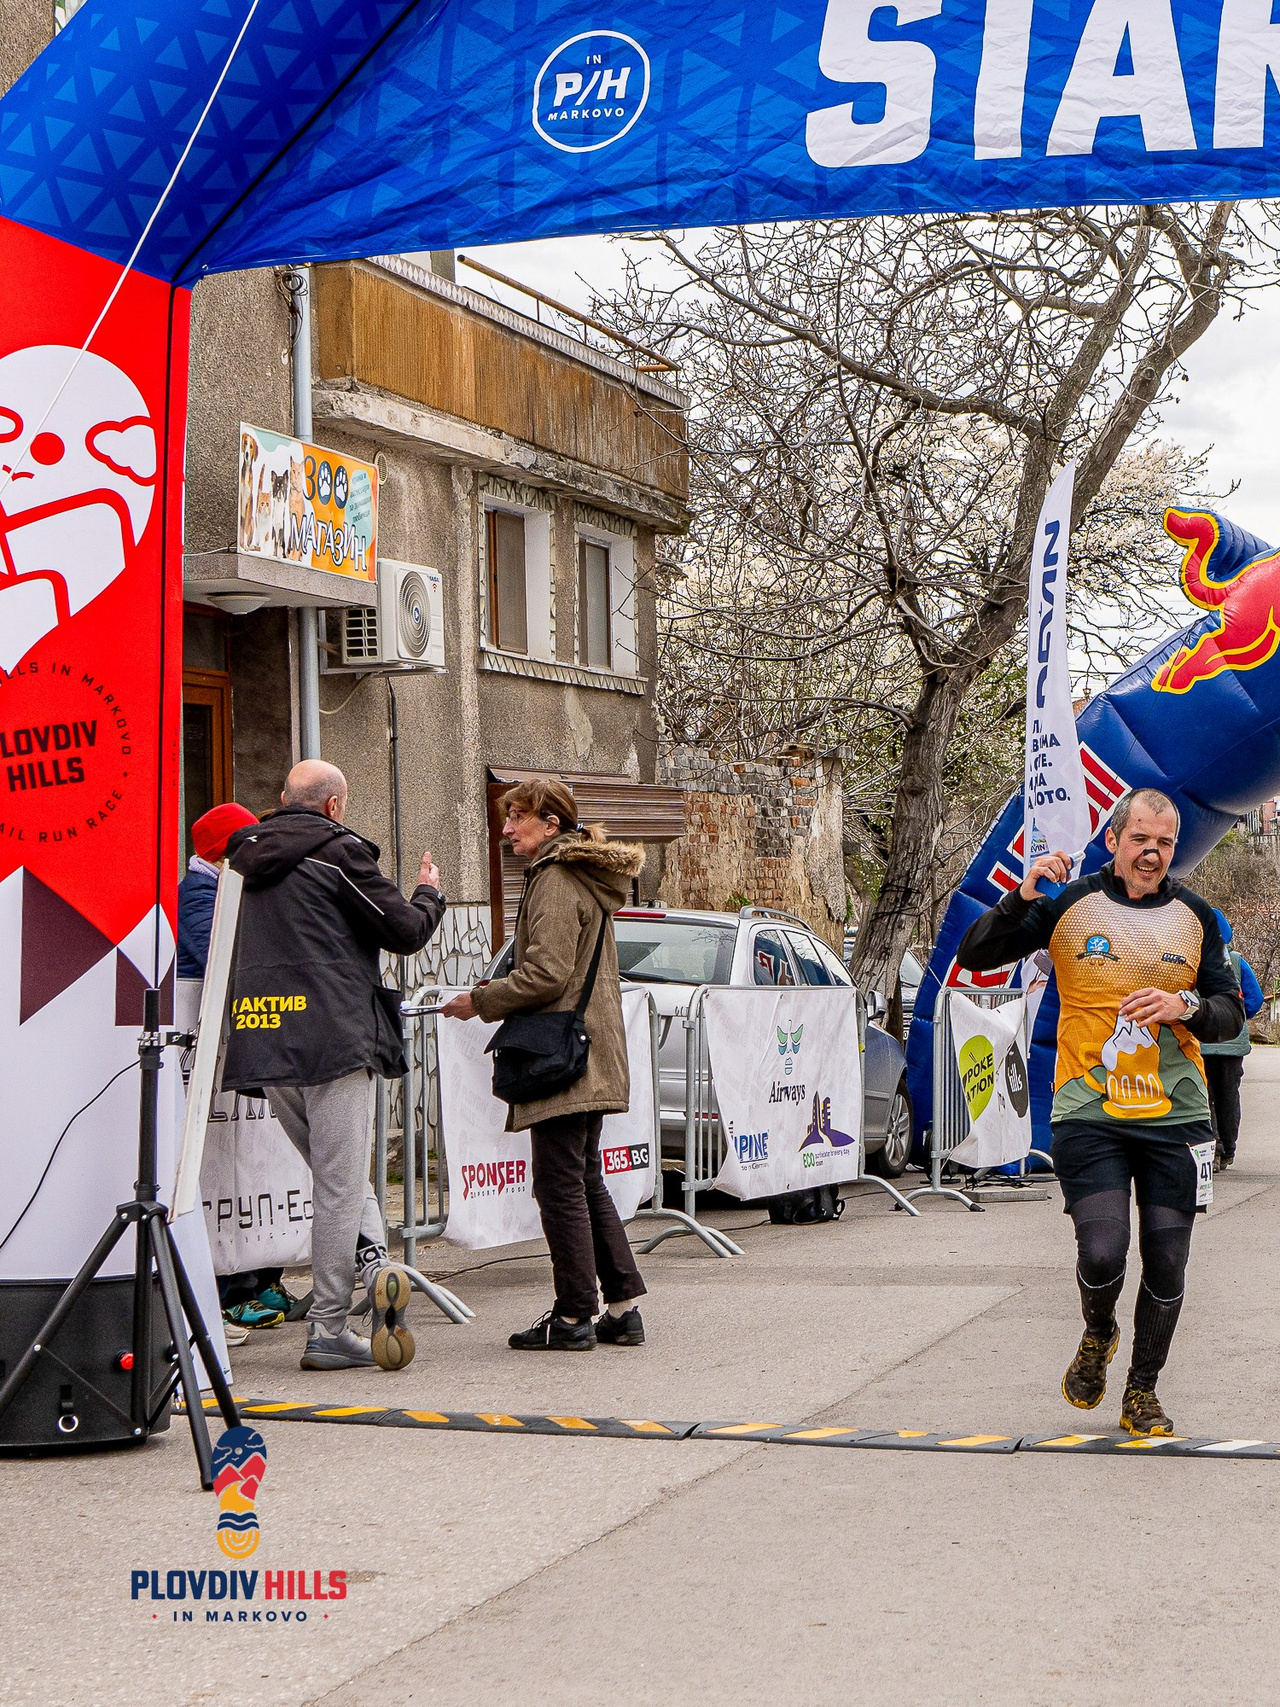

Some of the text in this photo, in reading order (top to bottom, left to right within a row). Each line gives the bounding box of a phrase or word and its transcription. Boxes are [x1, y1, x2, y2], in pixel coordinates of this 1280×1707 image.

[586, 54, 602, 65] IN
[553, 66, 632, 108] P/H
[548, 108, 625, 121] MARKOVO
[290, 512, 367, 571] МАГАЗИН
[52, 662, 72, 676] IN
[81, 674, 132, 756] MARKOVO
[0, 720, 98, 759] LOVDIV
[6, 756, 85, 793] HILLS
[39, 826, 78, 843] RUN
[86, 790, 122, 830] RACE
[239, 996, 308, 1013] АКТИВ
[236, 1014, 282, 1030] 2013
[769, 1081, 806, 1106] Airways
[606, 1148, 649, 1170] 365.BG
[803, 1152, 815, 1168] ECO
[461, 1160, 526, 1201] SPONSER
